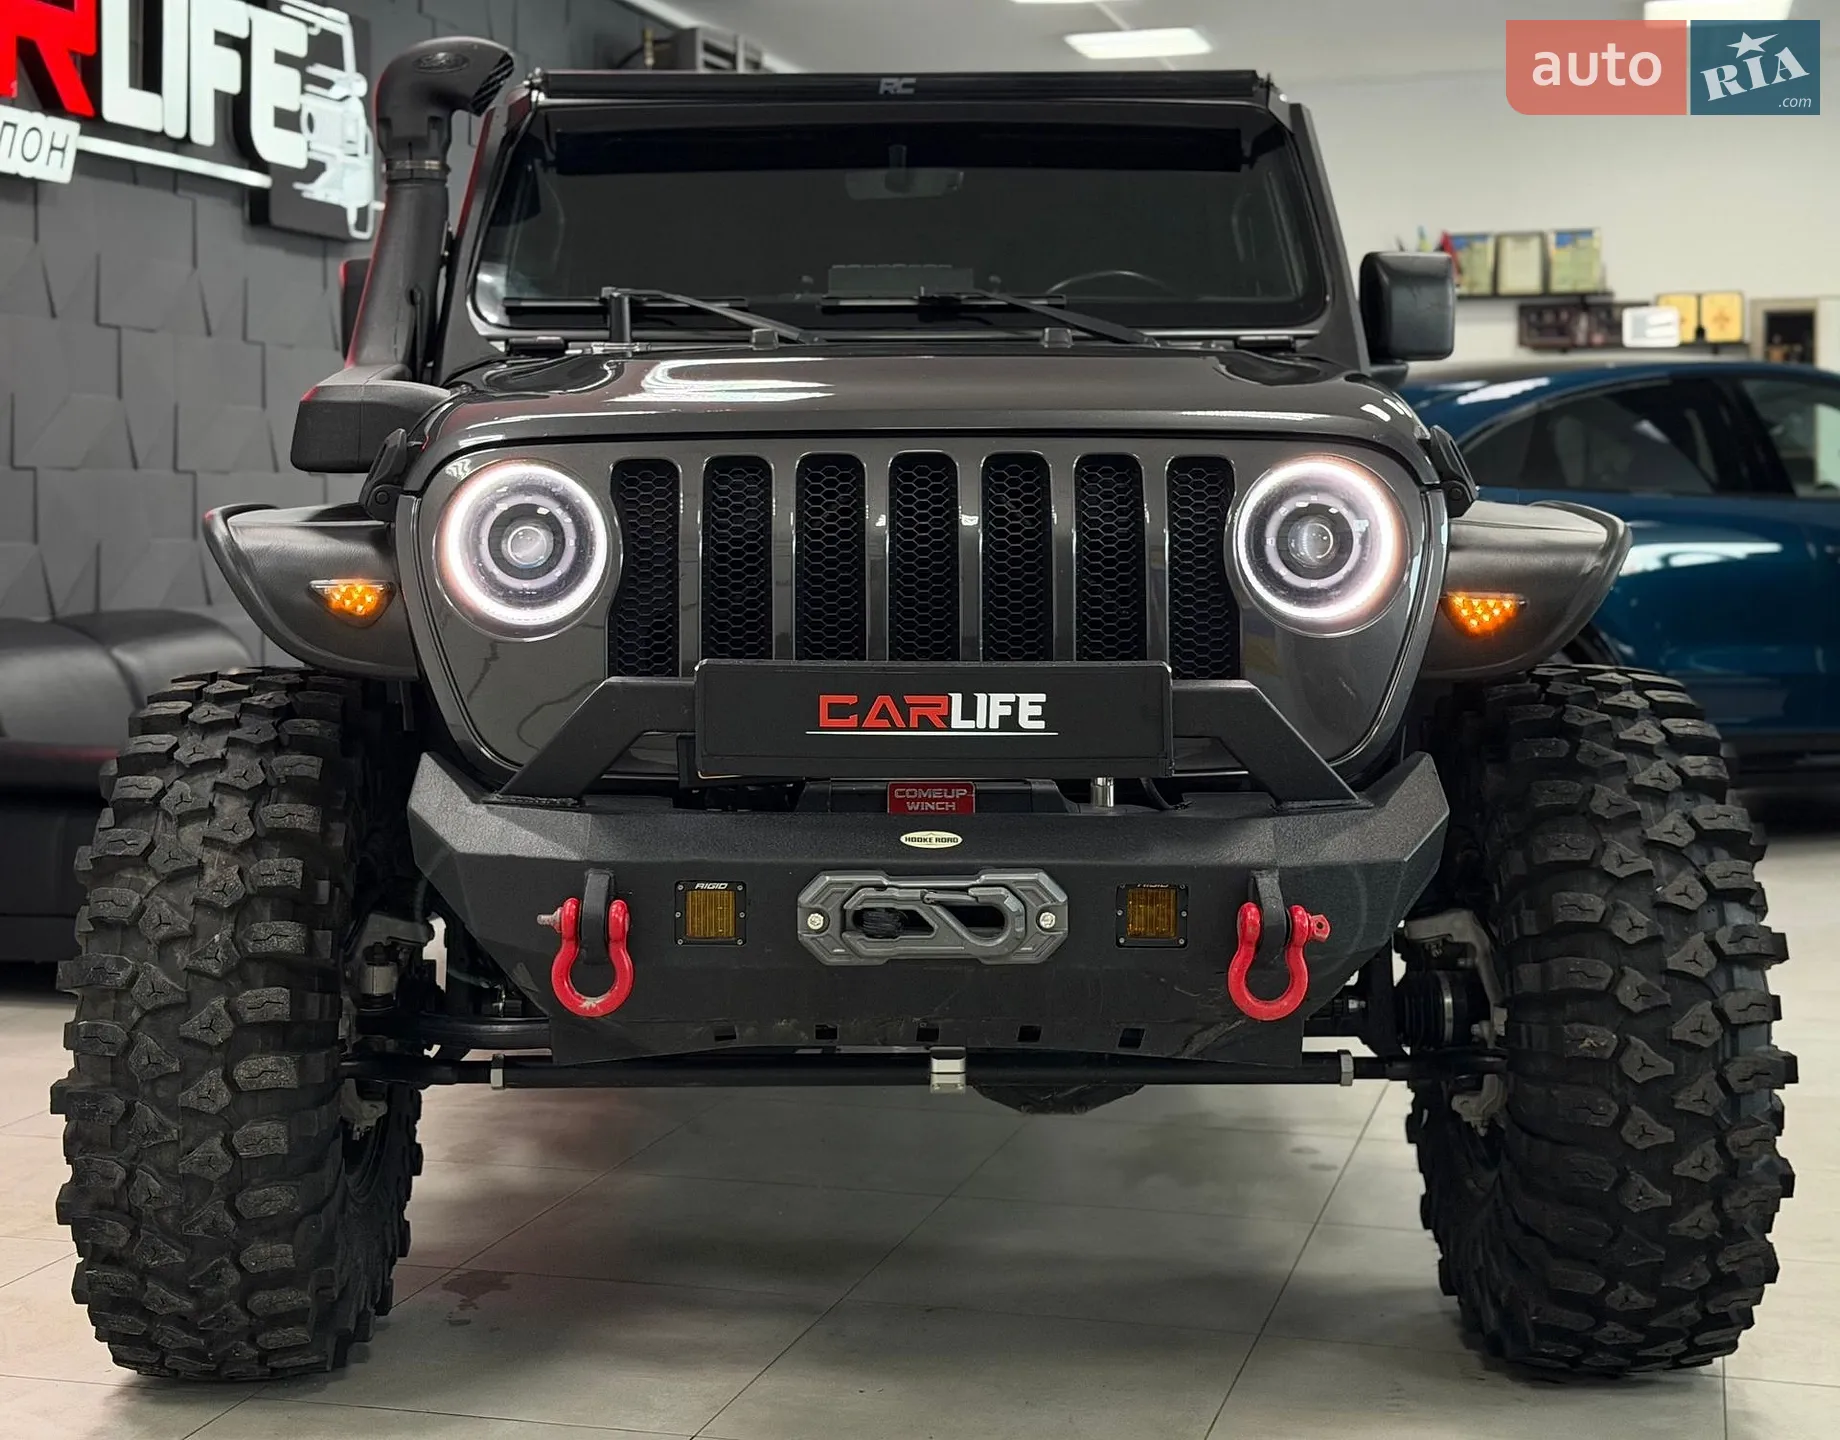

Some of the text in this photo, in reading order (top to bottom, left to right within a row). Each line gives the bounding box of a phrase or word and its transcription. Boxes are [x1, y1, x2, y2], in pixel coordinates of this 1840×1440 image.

[879, 77, 917, 95] RC
[819, 693, 1047, 729] CARLIFE
[894, 788, 968, 798] COMEUP
[906, 801, 956, 811] WINCH
[694, 882, 729, 890] RIGID
